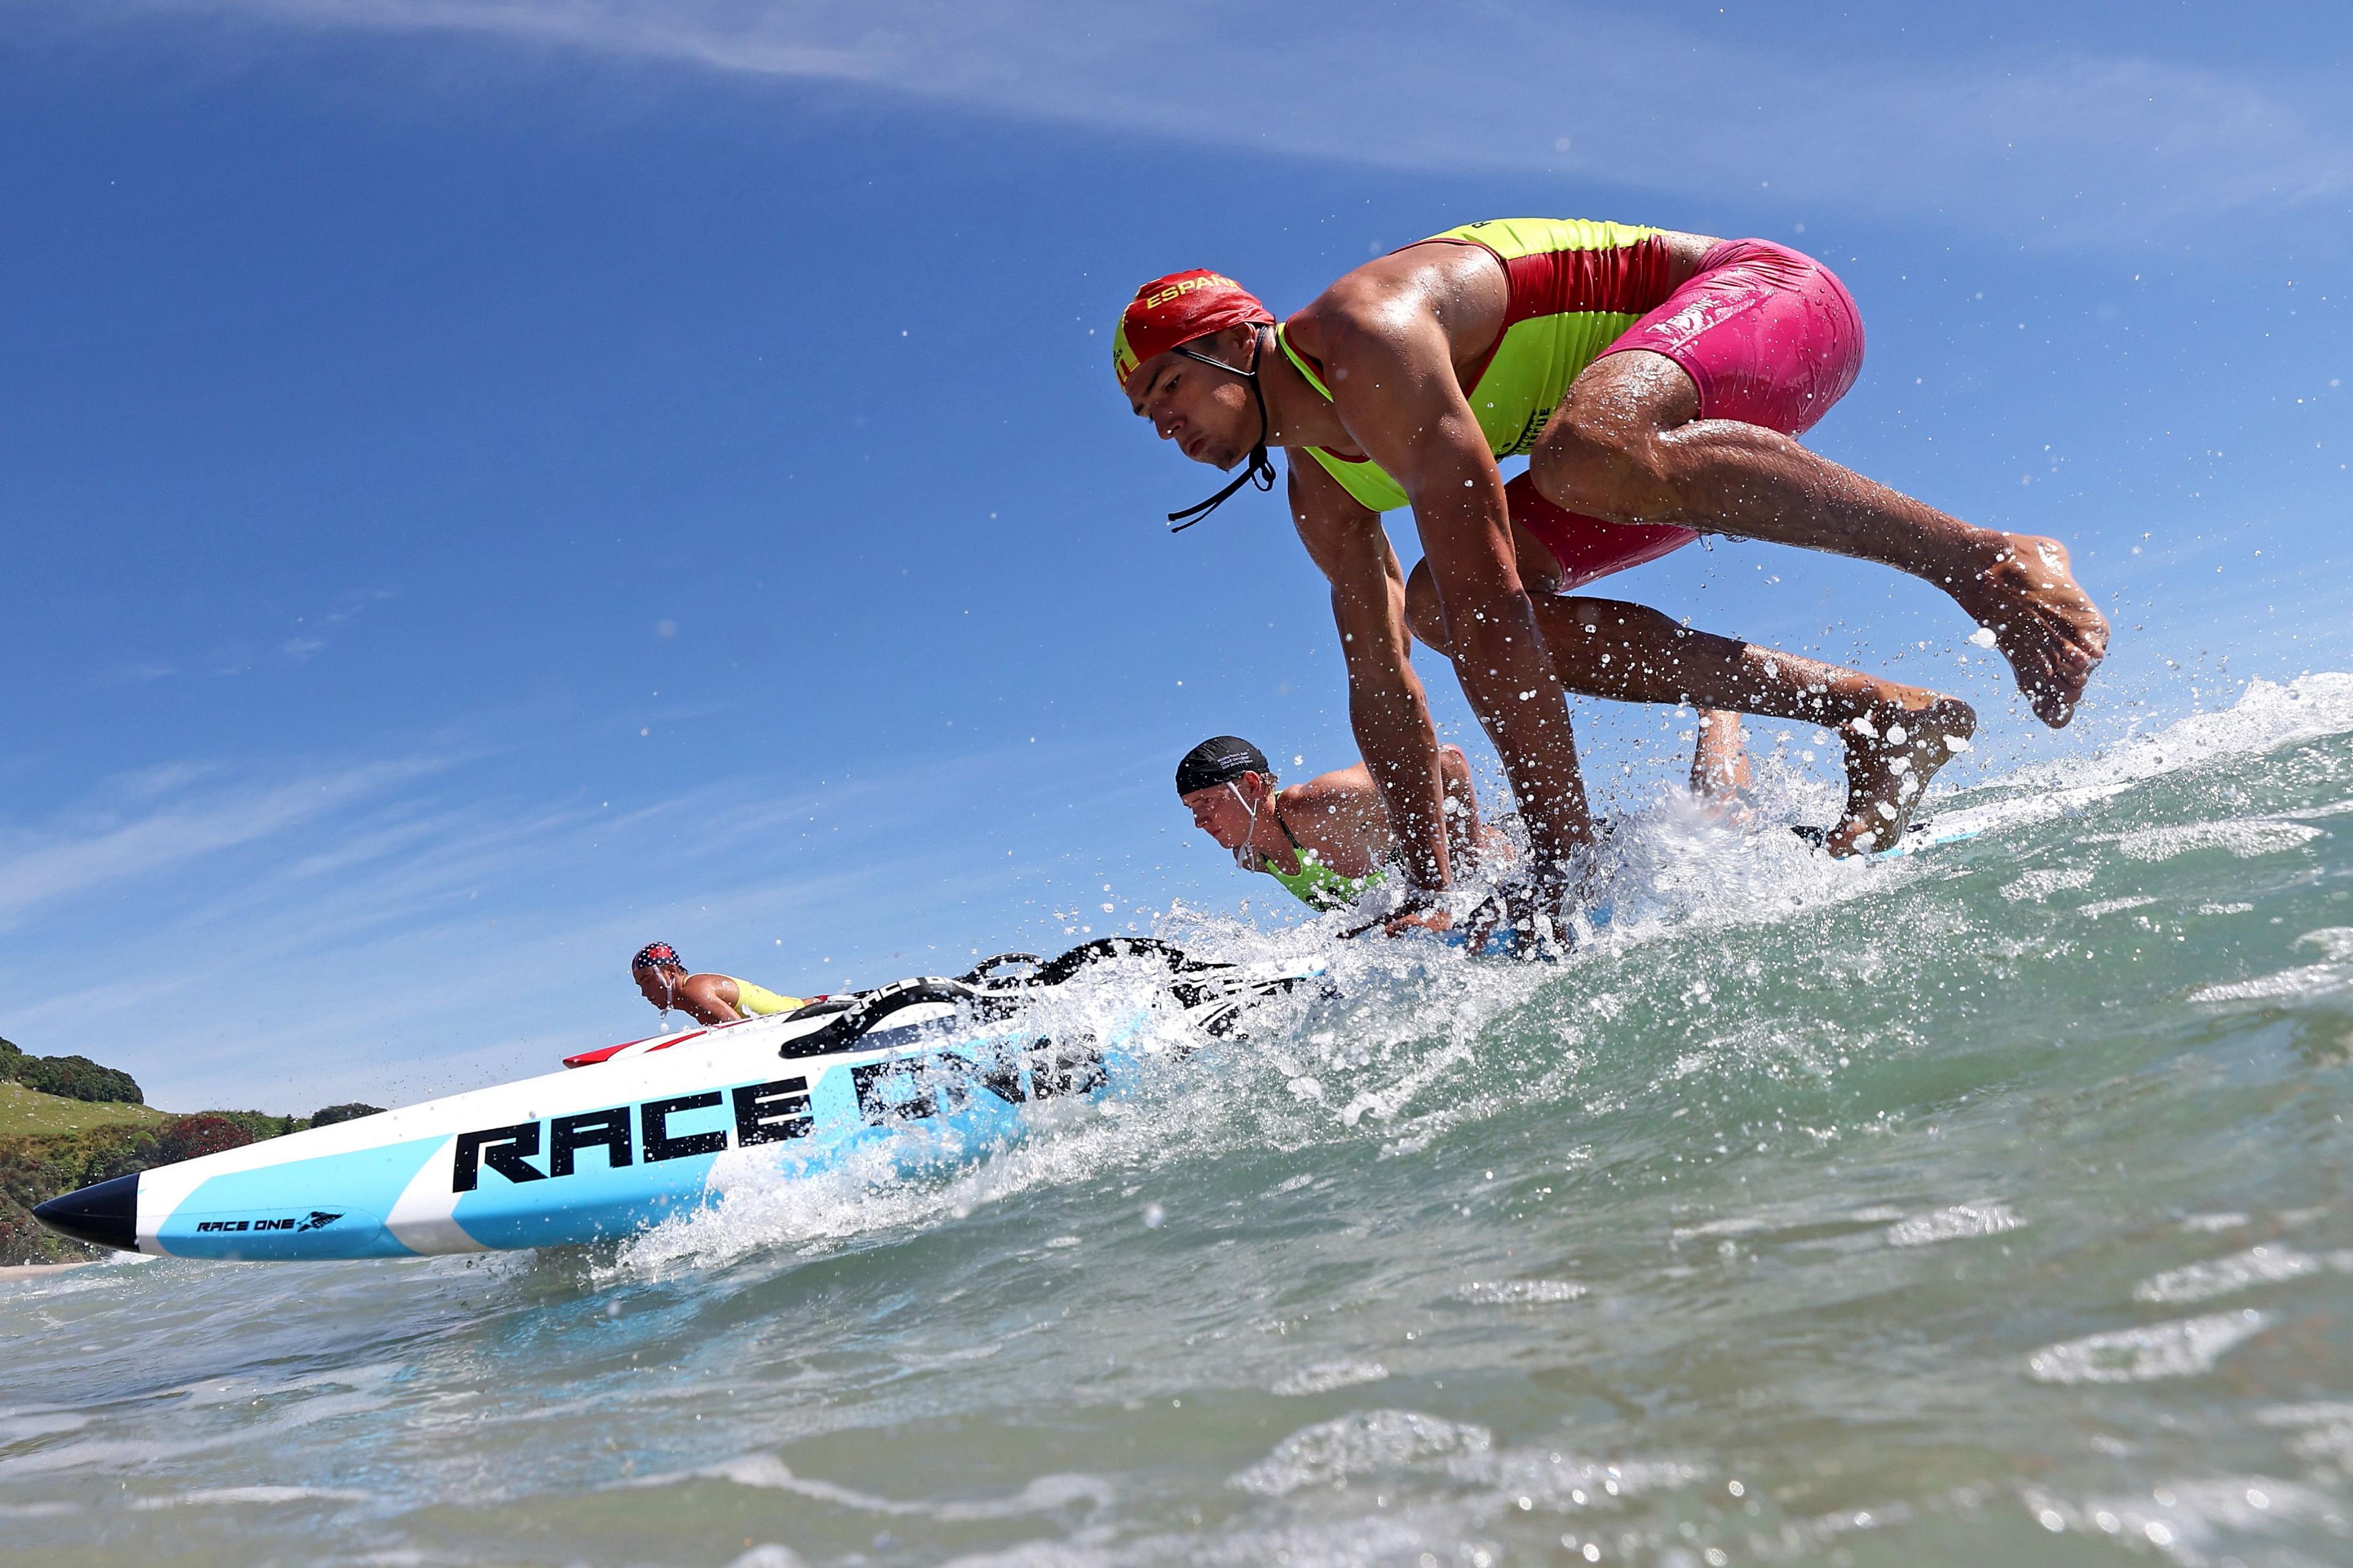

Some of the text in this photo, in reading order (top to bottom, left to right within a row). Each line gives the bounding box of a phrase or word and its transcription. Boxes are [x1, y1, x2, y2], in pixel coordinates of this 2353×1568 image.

[1665, 294, 1722, 331] ENGINE
[452, 1076, 815, 1193] RACE
[197, 1219, 295, 1232] RACE ONE
